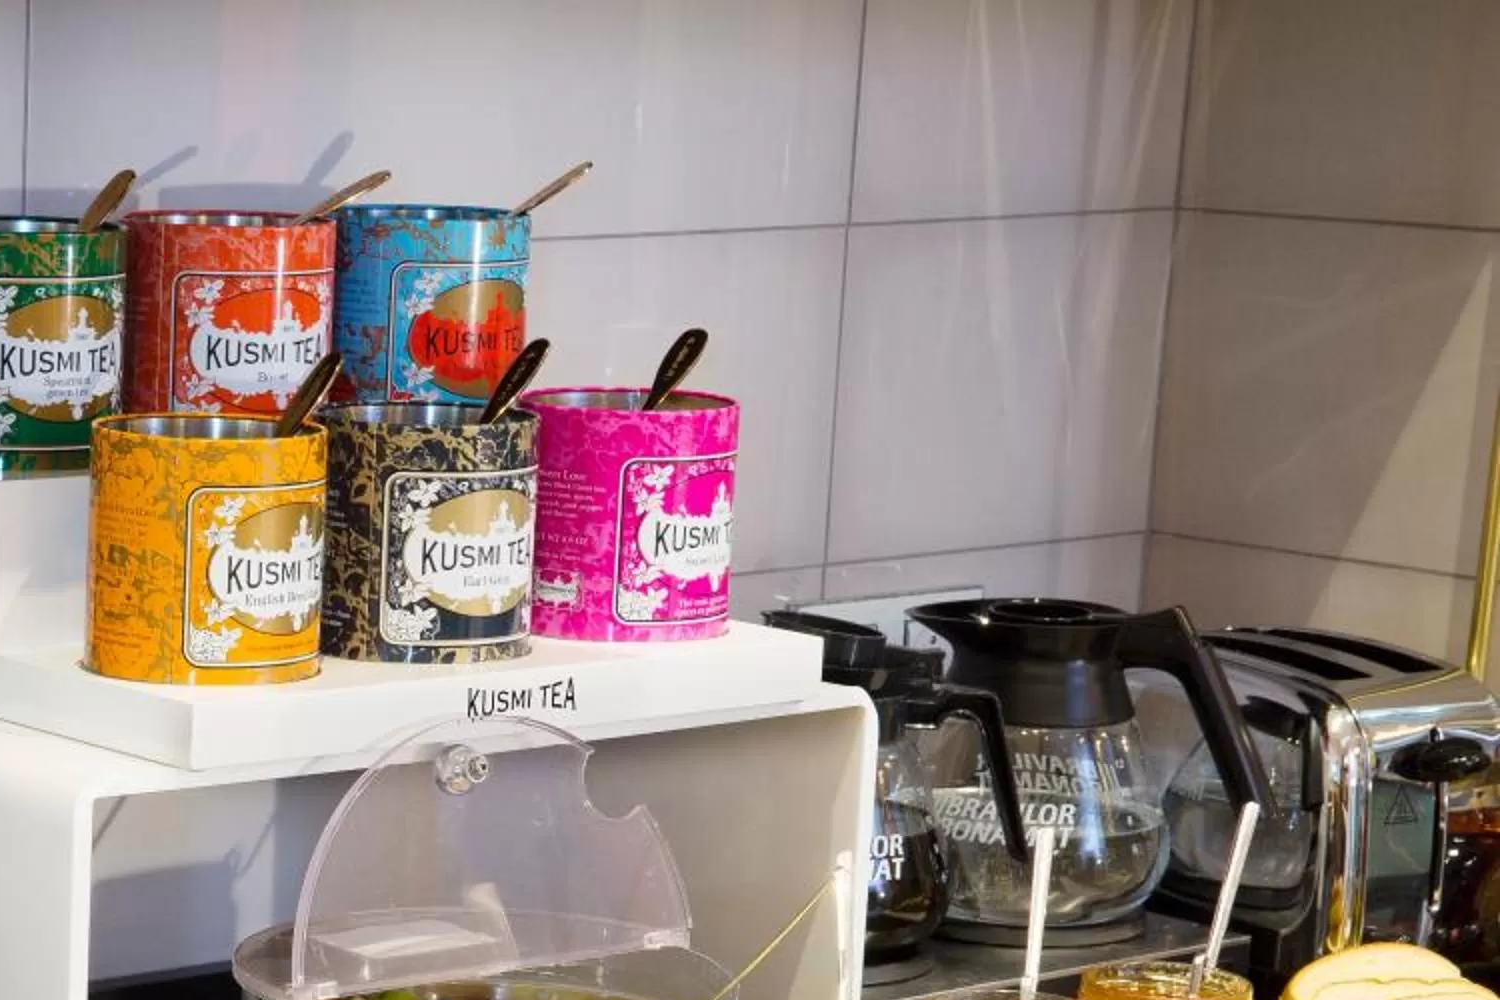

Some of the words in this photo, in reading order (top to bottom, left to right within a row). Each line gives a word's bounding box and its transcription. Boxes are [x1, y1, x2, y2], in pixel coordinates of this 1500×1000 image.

[206, 335, 285, 371] KUSMI
[426, 326, 497, 358] KUSMI
[0, 343, 81, 380] KUSMI
[421, 538, 501, 576] KUSMI
[655, 520, 719, 557] KUSMI
[227, 555, 301, 594] KUSMI
[467, 687, 532, 719] KUSMI
[539, 676, 577, 711] TEA
